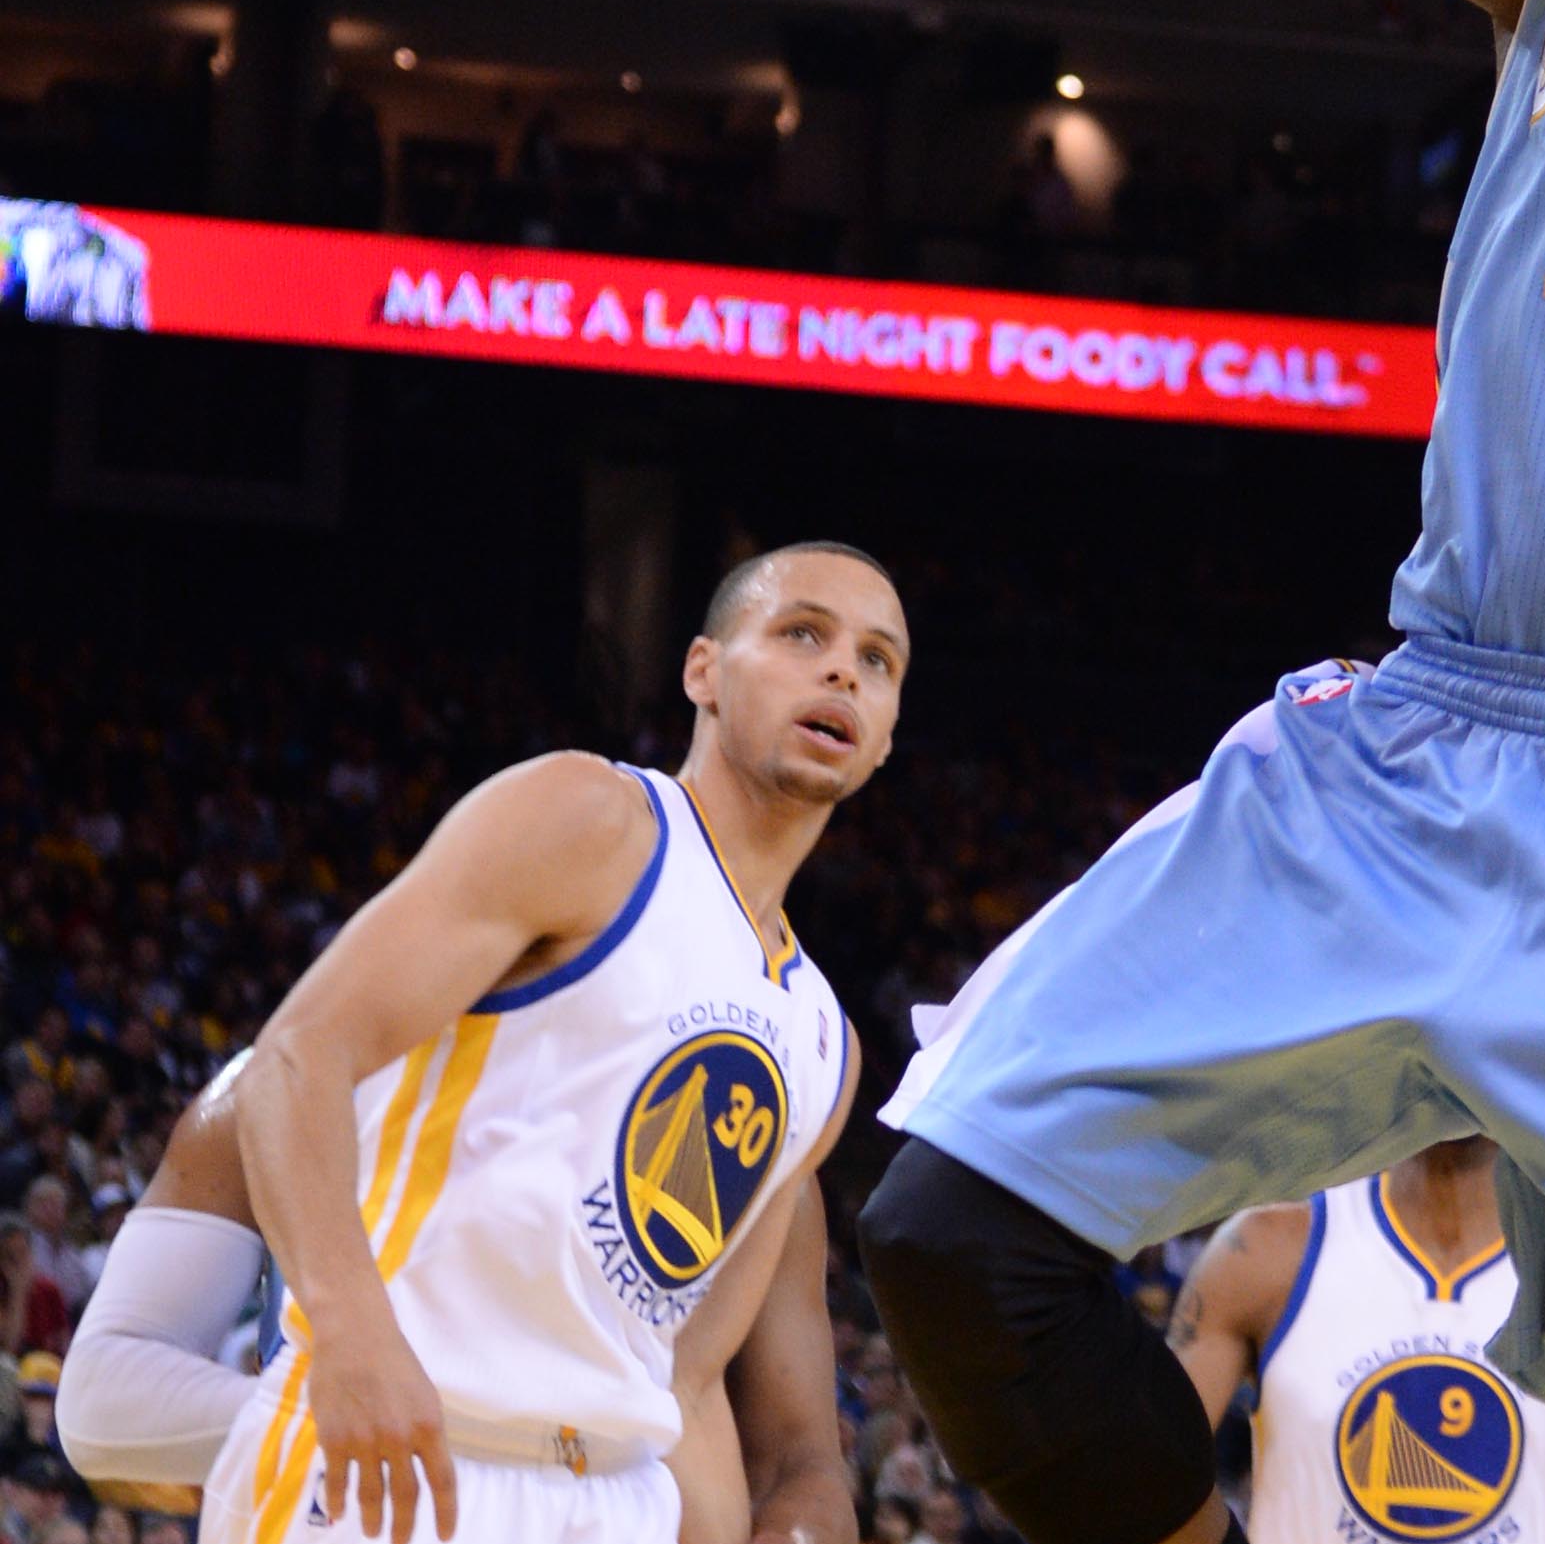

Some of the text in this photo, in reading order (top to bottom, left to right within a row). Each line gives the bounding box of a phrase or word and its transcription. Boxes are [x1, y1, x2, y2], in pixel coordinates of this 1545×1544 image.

[380, 268, 572, 338] MAKE
[581, 288, 630, 345] A
[642, 289, 788, 358] LATE
[799, 306, 976, 373] NIGHT
[989, 323, 1196, 392] FOODY
[668, 1001, 781, 1045] GOLDEN
[712, 1082, 774, 1169] 30
[1336, 1333, 1451, 1388] GOLDEN
[1438, 1386, 1475, 1438] 9
